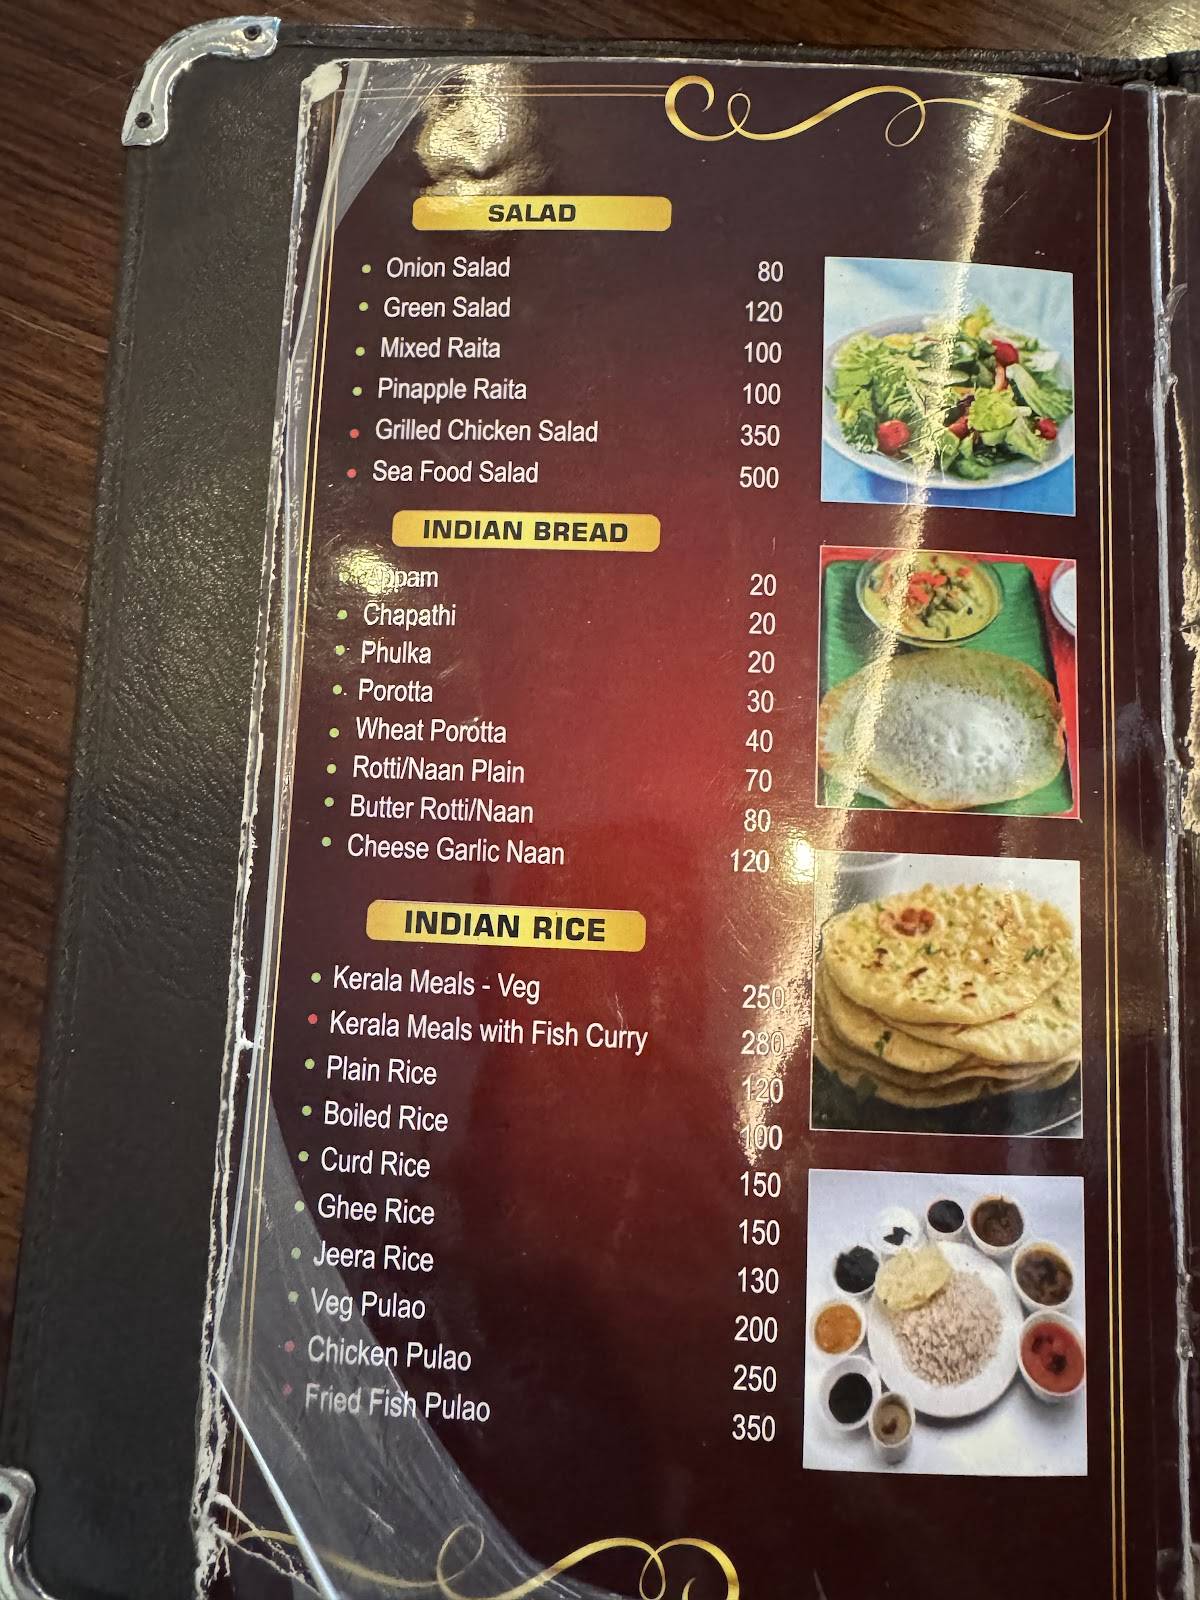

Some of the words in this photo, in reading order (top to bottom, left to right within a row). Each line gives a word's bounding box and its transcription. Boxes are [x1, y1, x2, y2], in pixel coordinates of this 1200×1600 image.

[488, 204, 576, 222] SALAD
[386, 258, 446, 278] Onion
[453, 257, 511, 278] Salad
[758, 261, 784, 282] 80
[383, 297, 446, 318] Green
[452, 297, 511, 318] Salad
[745, 302, 783, 323] 120
[380, 337, 440, 358] Mixed
[448, 338, 500, 359] Raita
[744, 343, 782, 364] 100
[377, 378, 467, 404] Pinapple
[474, 379, 527, 400] Raita
[743, 384, 781, 405] 100
[375, 419, 440, 440] Grilled
[447, 419, 531, 441] Chicken
[538, 420, 598, 443] Salad
[740, 425, 780, 447] 350
[372, 461, 413, 482] Sea
[420, 461, 472, 482] Food
[479, 462, 539, 484] Salad
[740, 467, 779, 489] 500
[423, 520, 523, 540] INDIAN
[534, 522, 628, 542] BREAD
[750, 574, 776, 596] 20
[363, 604, 456, 628] Chapathi
[749, 613, 776, 635] 20
[361, 640, 431, 664] Phulka
[748, 651, 775, 674] 20
[358, 679, 433, 702] Porotta
[747, 690, 774, 713] 30
[356, 717, 424, 741] Wheat
[431, 719, 507, 744] Porotta
[745, 730, 773, 752] 40
[353, 756, 464, 781] Rotti/Naan
[472, 759, 525, 783] Plain
[746, 769, 772, 792] 70
[350, 795, 414, 819] Butter
[420, 797, 534, 823] Rotti/Naan
[744, 809, 771, 832] 80
[347, 834, 429, 859] Cheese
[436, 837, 500, 862] Garlic
[506, 840, 565, 865] Naan
[730, 850, 770, 872] 120
[405, 910, 520, 938] INDIAN
[533, 915, 606, 942] RICE
[333, 965, 402, 992] Kerala
[410, 970, 475, 996] Meals
[497, 973, 540, 1004] Veg
[742, 985, 785, 1008] 250
[329, 1010, 399, 1037] Kerala
[407, 1014, 472, 1041] Meals
[479, 1018, 524, 1044] with
[532, 1019, 578, 1046] Fish
[586, 1023, 648, 1055] Curry
[741, 1030, 784, 1055] 280
[326, 1056, 380, 1081] Plain
[388, 1059, 437, 1085] Rice
[742, 1078, 784, 1103] 120
[323, 1101, 391, 1129] Boiled
[399, 1105, 448, 1132] Rice
[741, 1125, 782, 1150] 100
[320, 1147, 373, 1175] Curd
[381, 1150, 430, 1178] Rice
[740, 1172, 781, 1197] 150
[317, 1193, 377, 1221] Ghee
[385, 1198, 435, 1225] Rice
[739, 1220, 780, 1245] 150
[313, 1242, 375, 1269] Jeera
[384, 1245, 434, 1272] Rice
[738, 1268, 779, 1294] 130
[311, 1288, 353, 1321] Veg
[361, 1291, 426, 1320] Pulao
[734, 1316, 778, 1342] 200
[307, 1335, 398, 1367] Chicken
[407, 1342, 472, 1371] Pulao
[733, 1366, 777, 1392] 250
[304, 1383, 360, 1414] Fried
[369, 1388, 416, 1418] Fish
[425, 1392, 490, 1422] Pulao
[732, 1415, 776, 1442] 350
